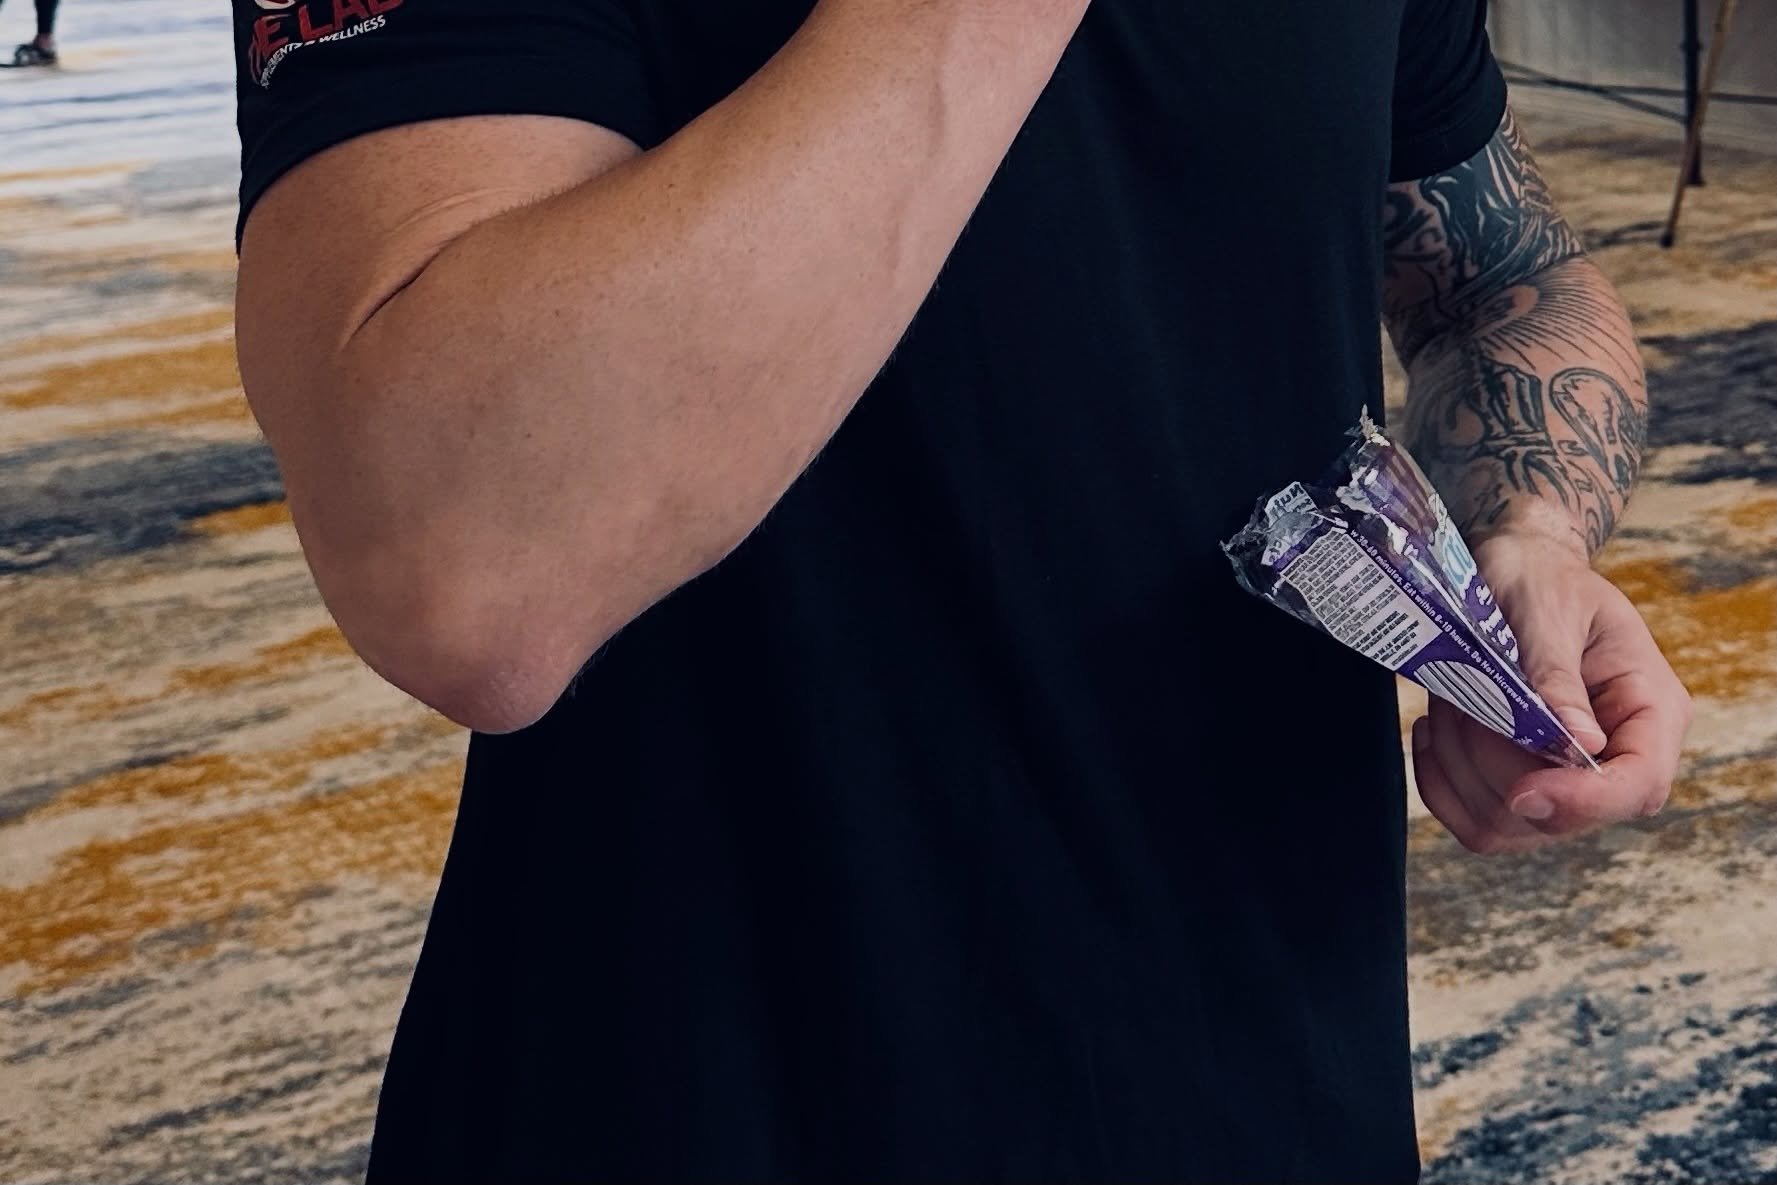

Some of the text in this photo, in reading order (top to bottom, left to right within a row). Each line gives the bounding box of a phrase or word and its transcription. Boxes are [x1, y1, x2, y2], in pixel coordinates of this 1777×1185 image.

[319, 14, 386, 42] WELLNESS
[1402, 582, 1417, 597] Eat
[1415, 594, 1436, 616] within
[1471, 650, 1482, 663] Do
[1480, 660, 1496, 676] Not
